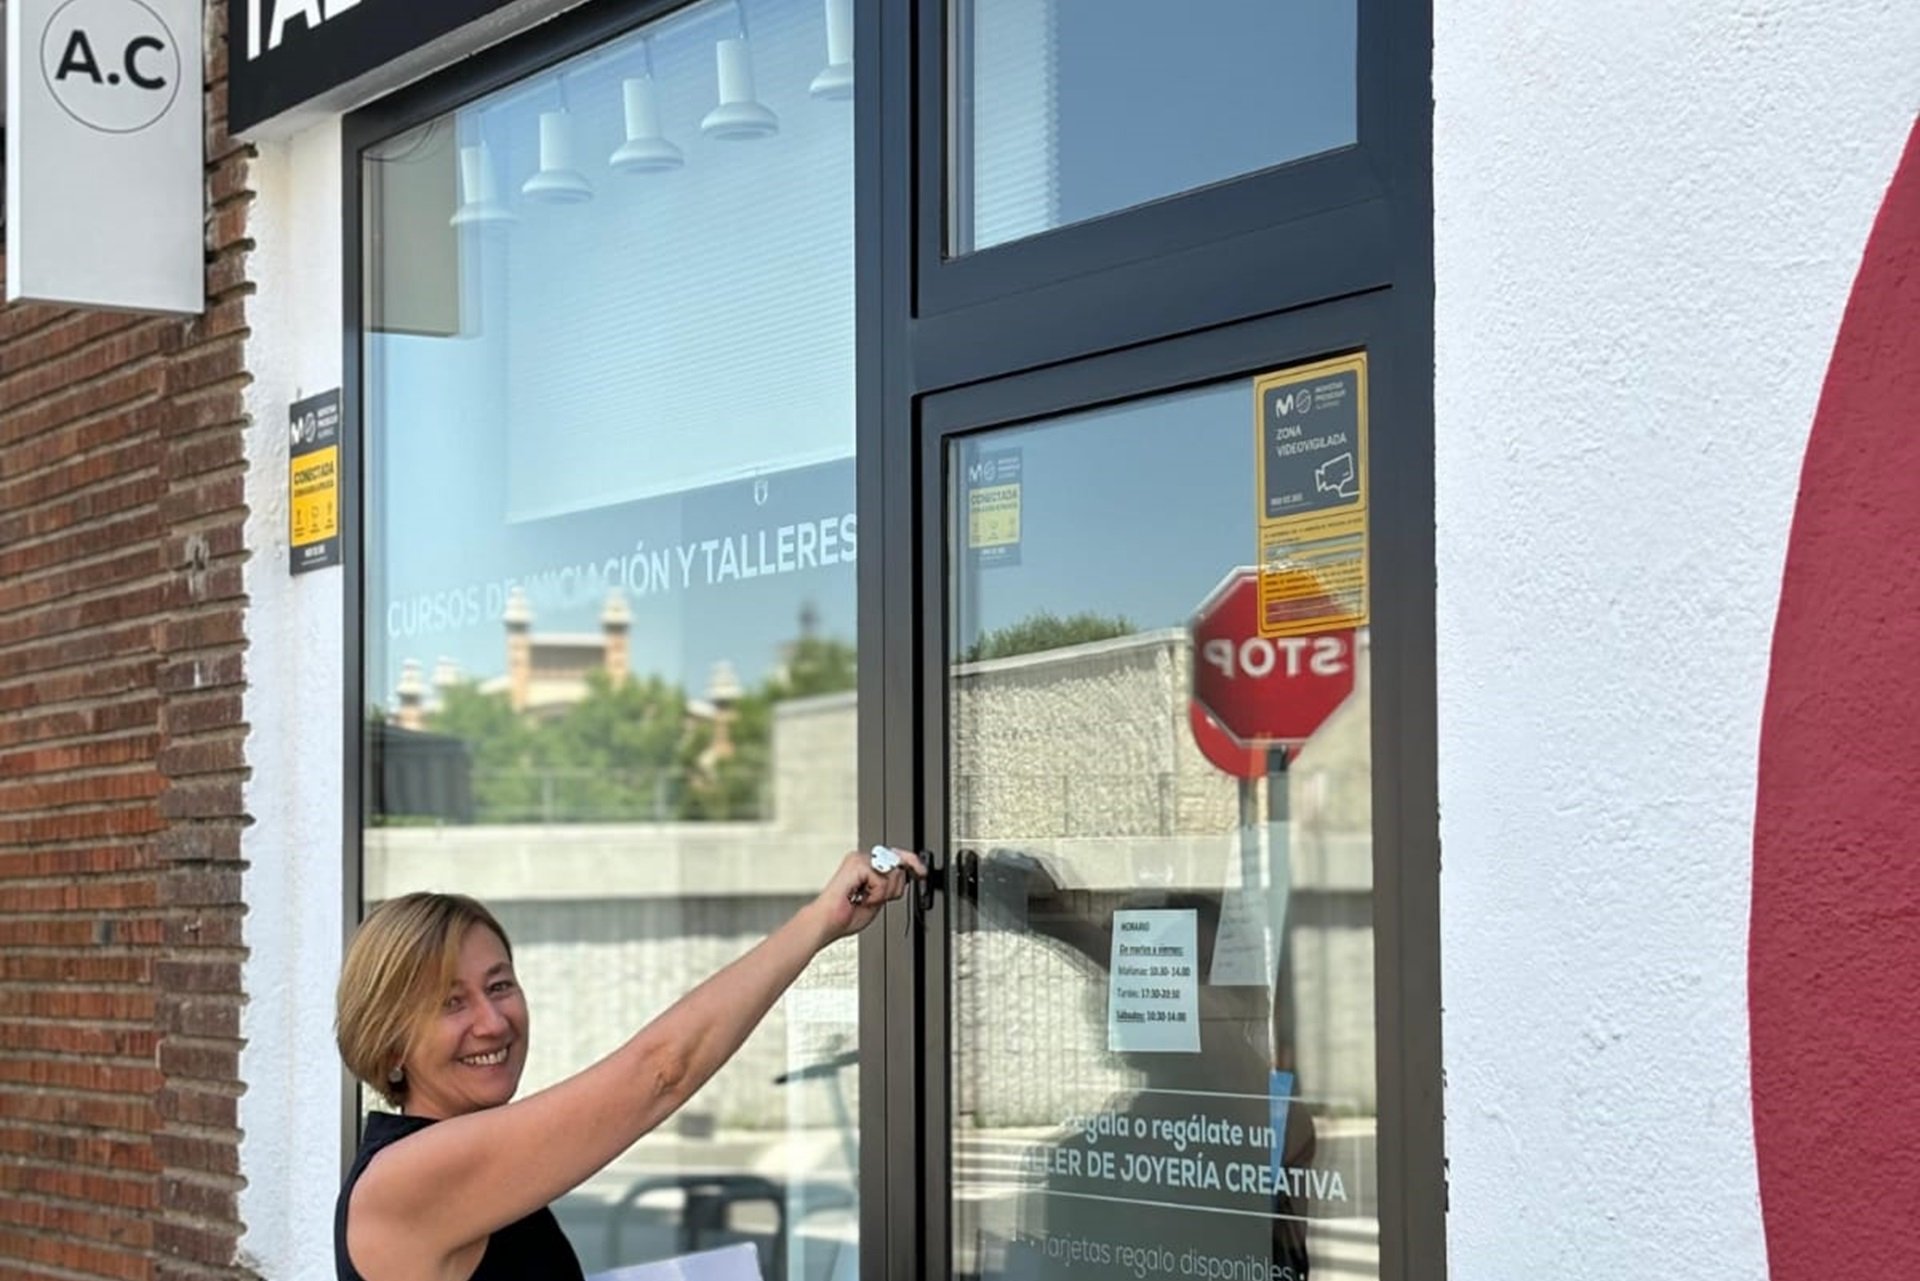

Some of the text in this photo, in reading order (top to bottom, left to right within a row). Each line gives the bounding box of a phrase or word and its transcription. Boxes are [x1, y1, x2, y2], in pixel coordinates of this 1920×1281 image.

[55, 30, 167, 90] A.C
[1276, 424, 1303, 440] ZONA
[1276, 432, 1347, 457] VIDEOVIGILADA
[387, 585, 480, 639] CURSOS
[676, 543, 696, 589] Y
[701, 513, 857, 585] TALLERES
[1121, 921, 1150, 932] HORARIO
[1134, 1117, 1147, 1139] o
[1152, 1114, 1243, 1152] regálate
[1249, 1125, 1276, 1148] un
[1087, 1150, 1115, 1180] DE
[1120, 1152, 1221, 1190] JOYERÍA
[1225, 1162, 1347, 1203] CREATIVA
[1116, 1244, 1175, 1278] regalo
[1180, 1248, 1293, 1281] disponibles
